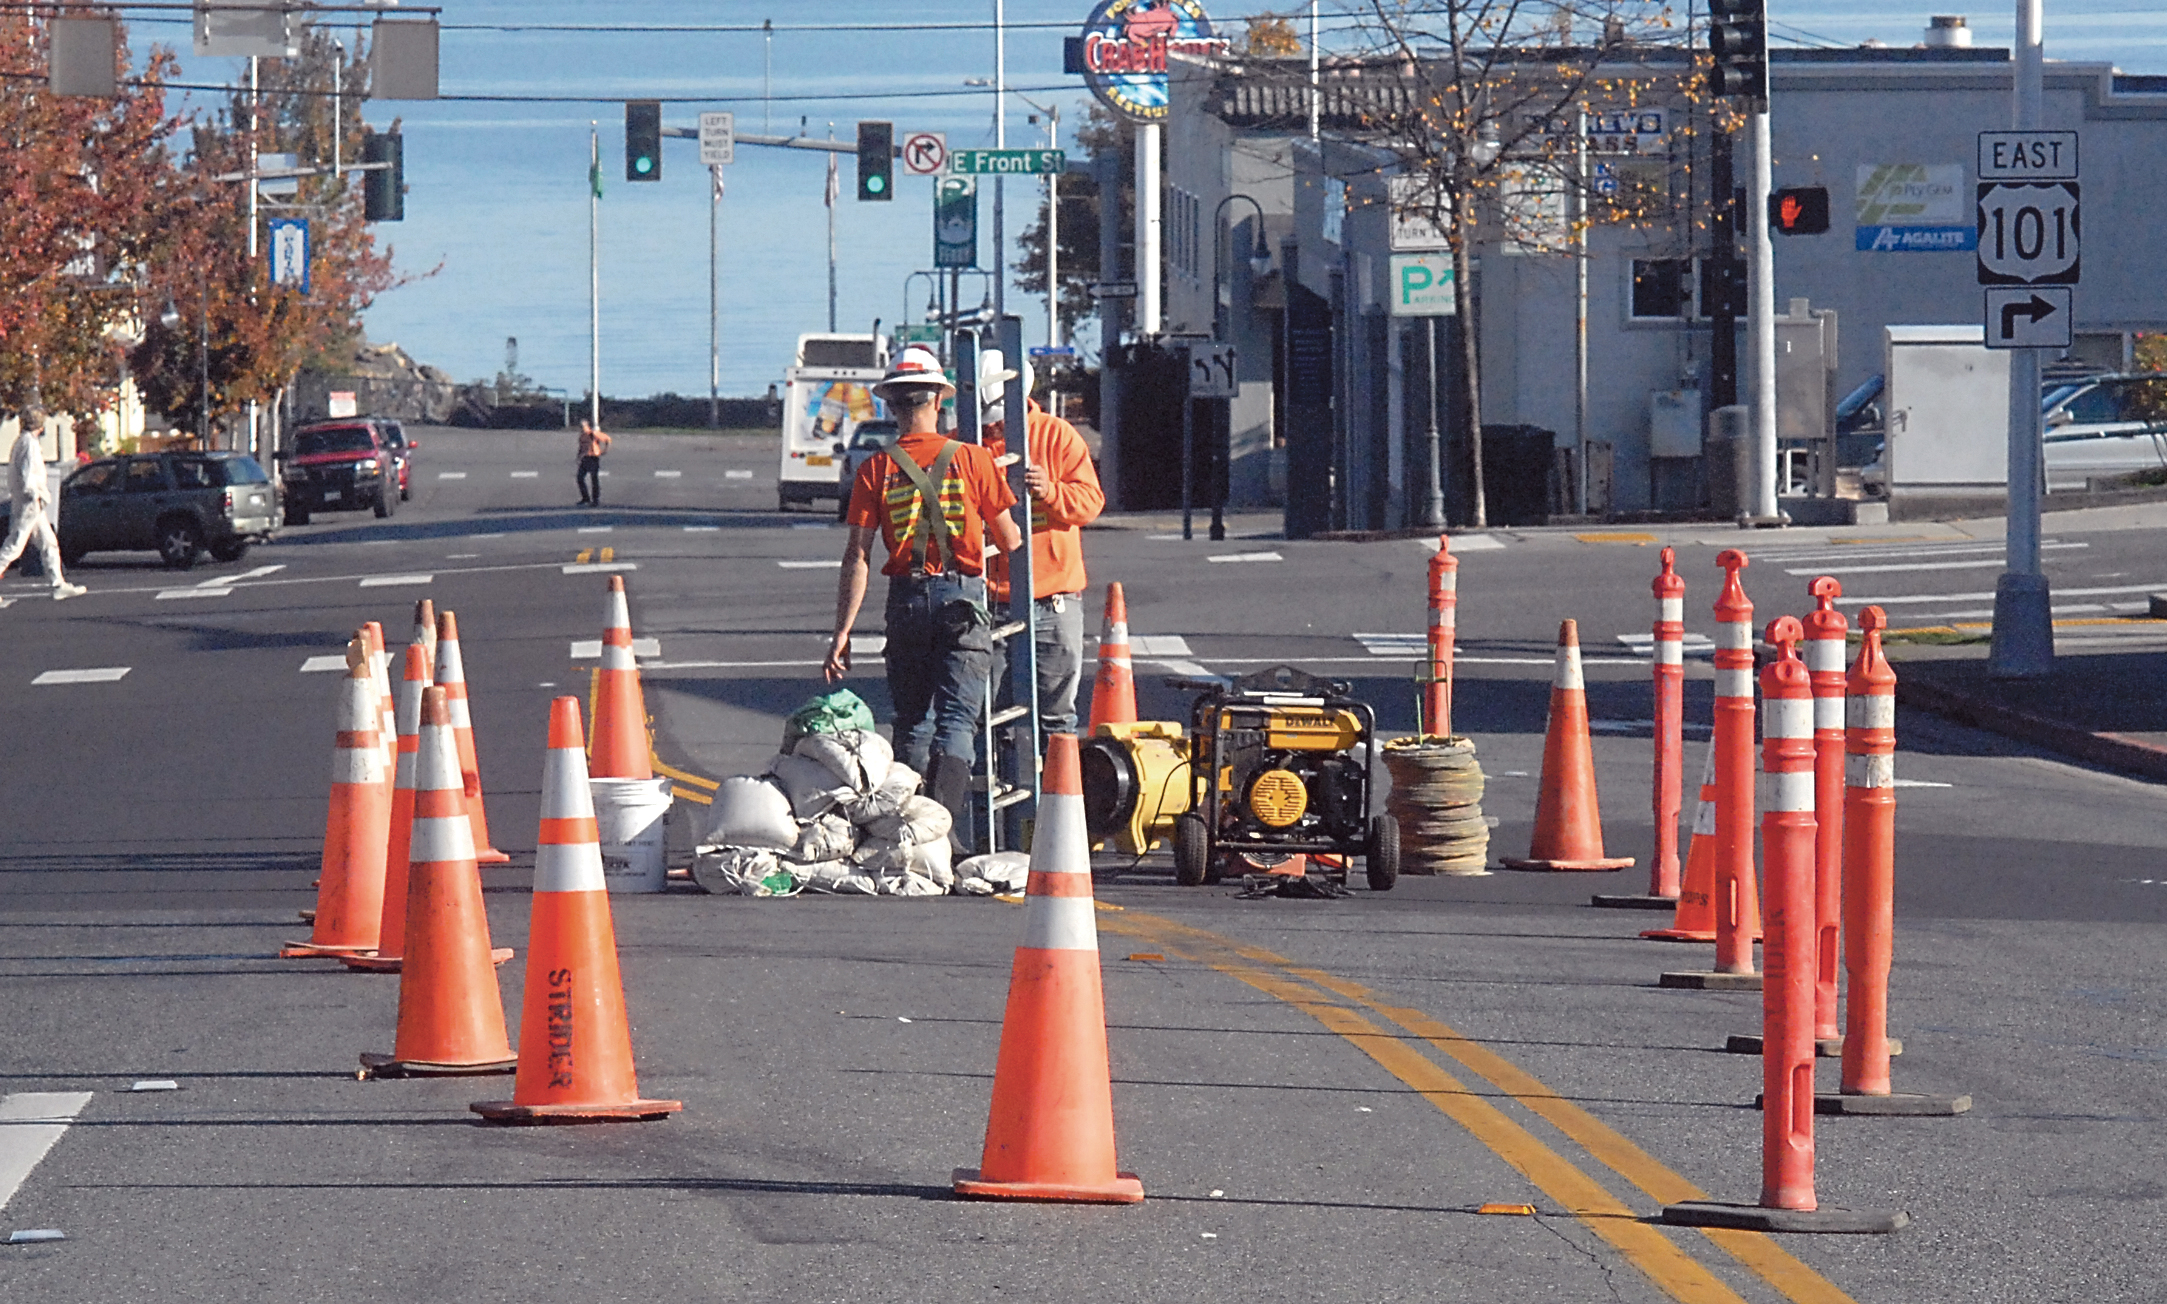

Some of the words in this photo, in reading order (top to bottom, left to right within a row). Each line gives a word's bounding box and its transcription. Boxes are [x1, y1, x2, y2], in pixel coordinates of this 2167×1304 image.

[705, 116, 727, 126] LEFT
[953, 152, 967, 172] E
[975, 152, 1031, 172] Front
[1041, 151, 1062, 172] St
[1993, 141, 2062, 168] EAST
[1992, 206, 2065, 260] 101
[548, 968, 573, 1090] STRIDER
